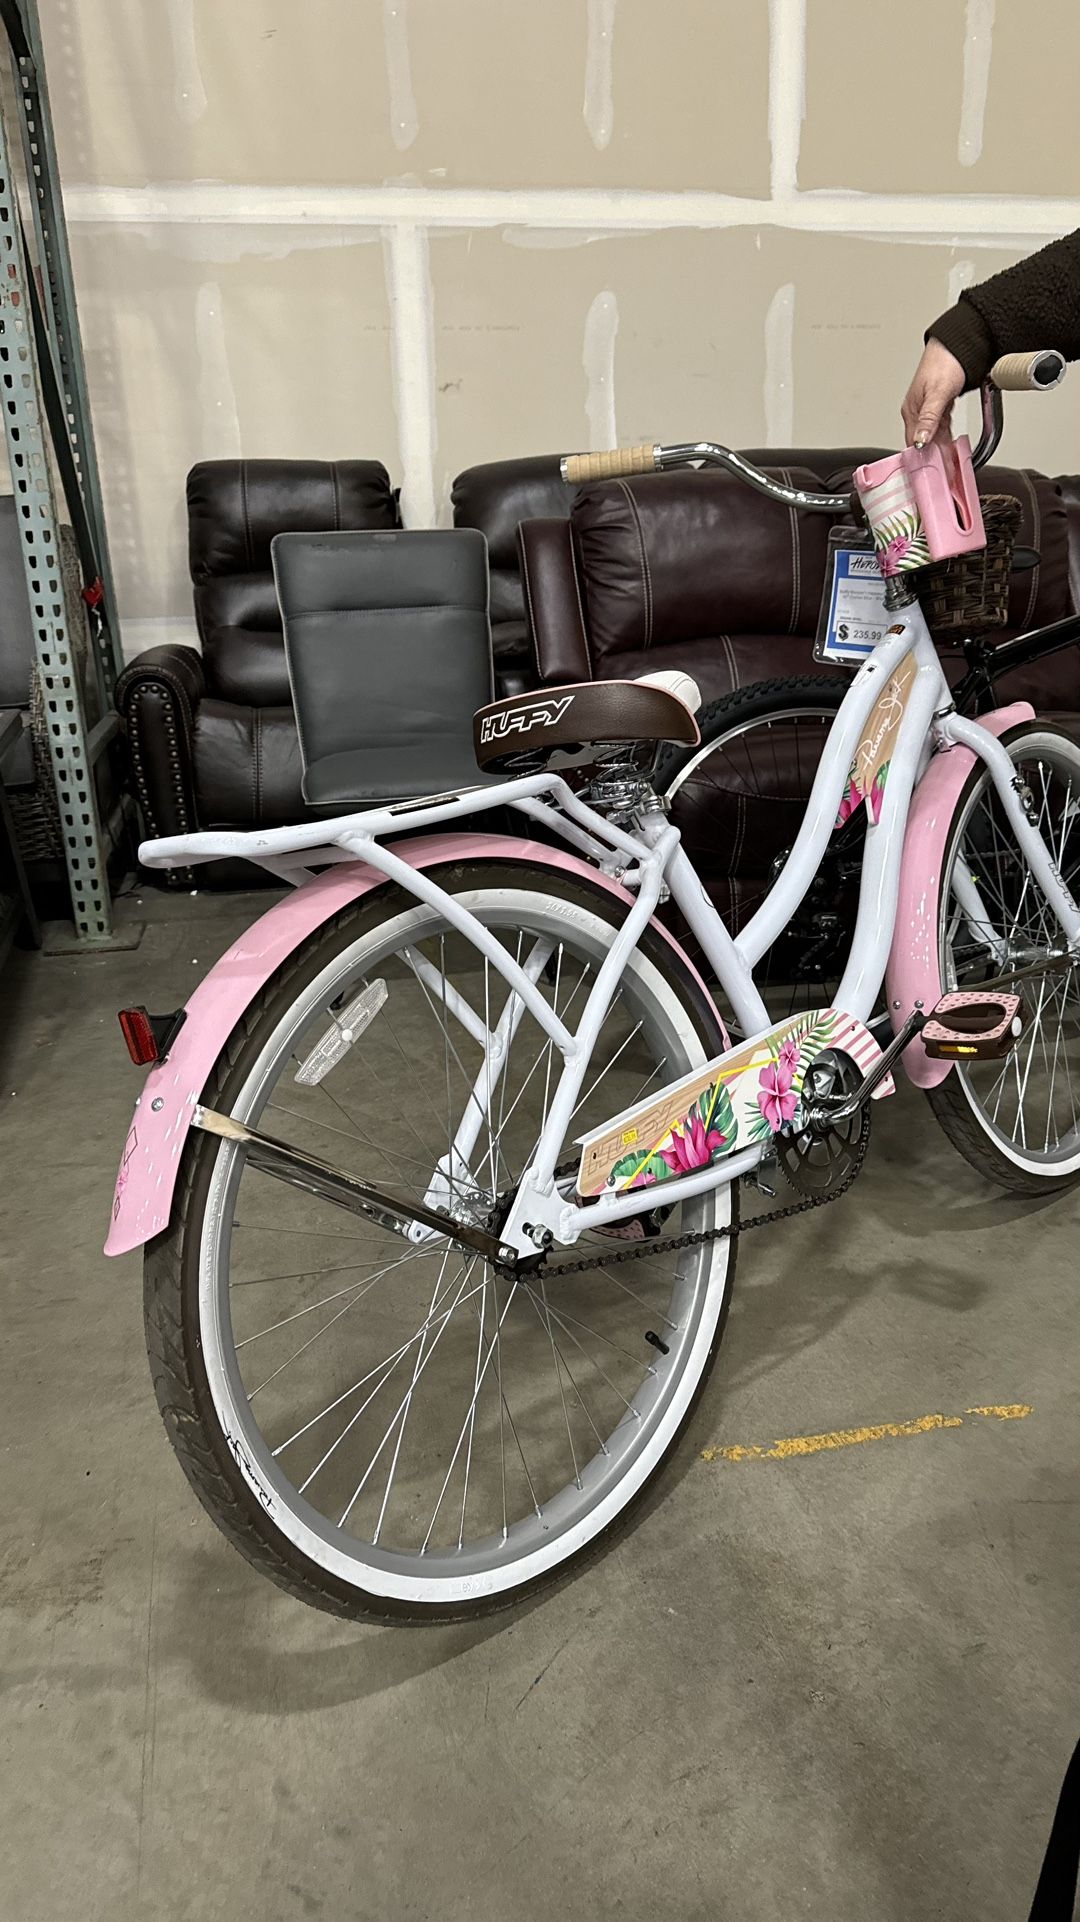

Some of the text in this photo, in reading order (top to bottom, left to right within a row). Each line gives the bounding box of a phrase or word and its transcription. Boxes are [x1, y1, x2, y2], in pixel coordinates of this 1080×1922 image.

[838, 624, 849, 641] $
[853, 630, 882, 641] 235.99
[480, 695, 576, 744] HUFFY
[853, 717, 892, 770] Panama
